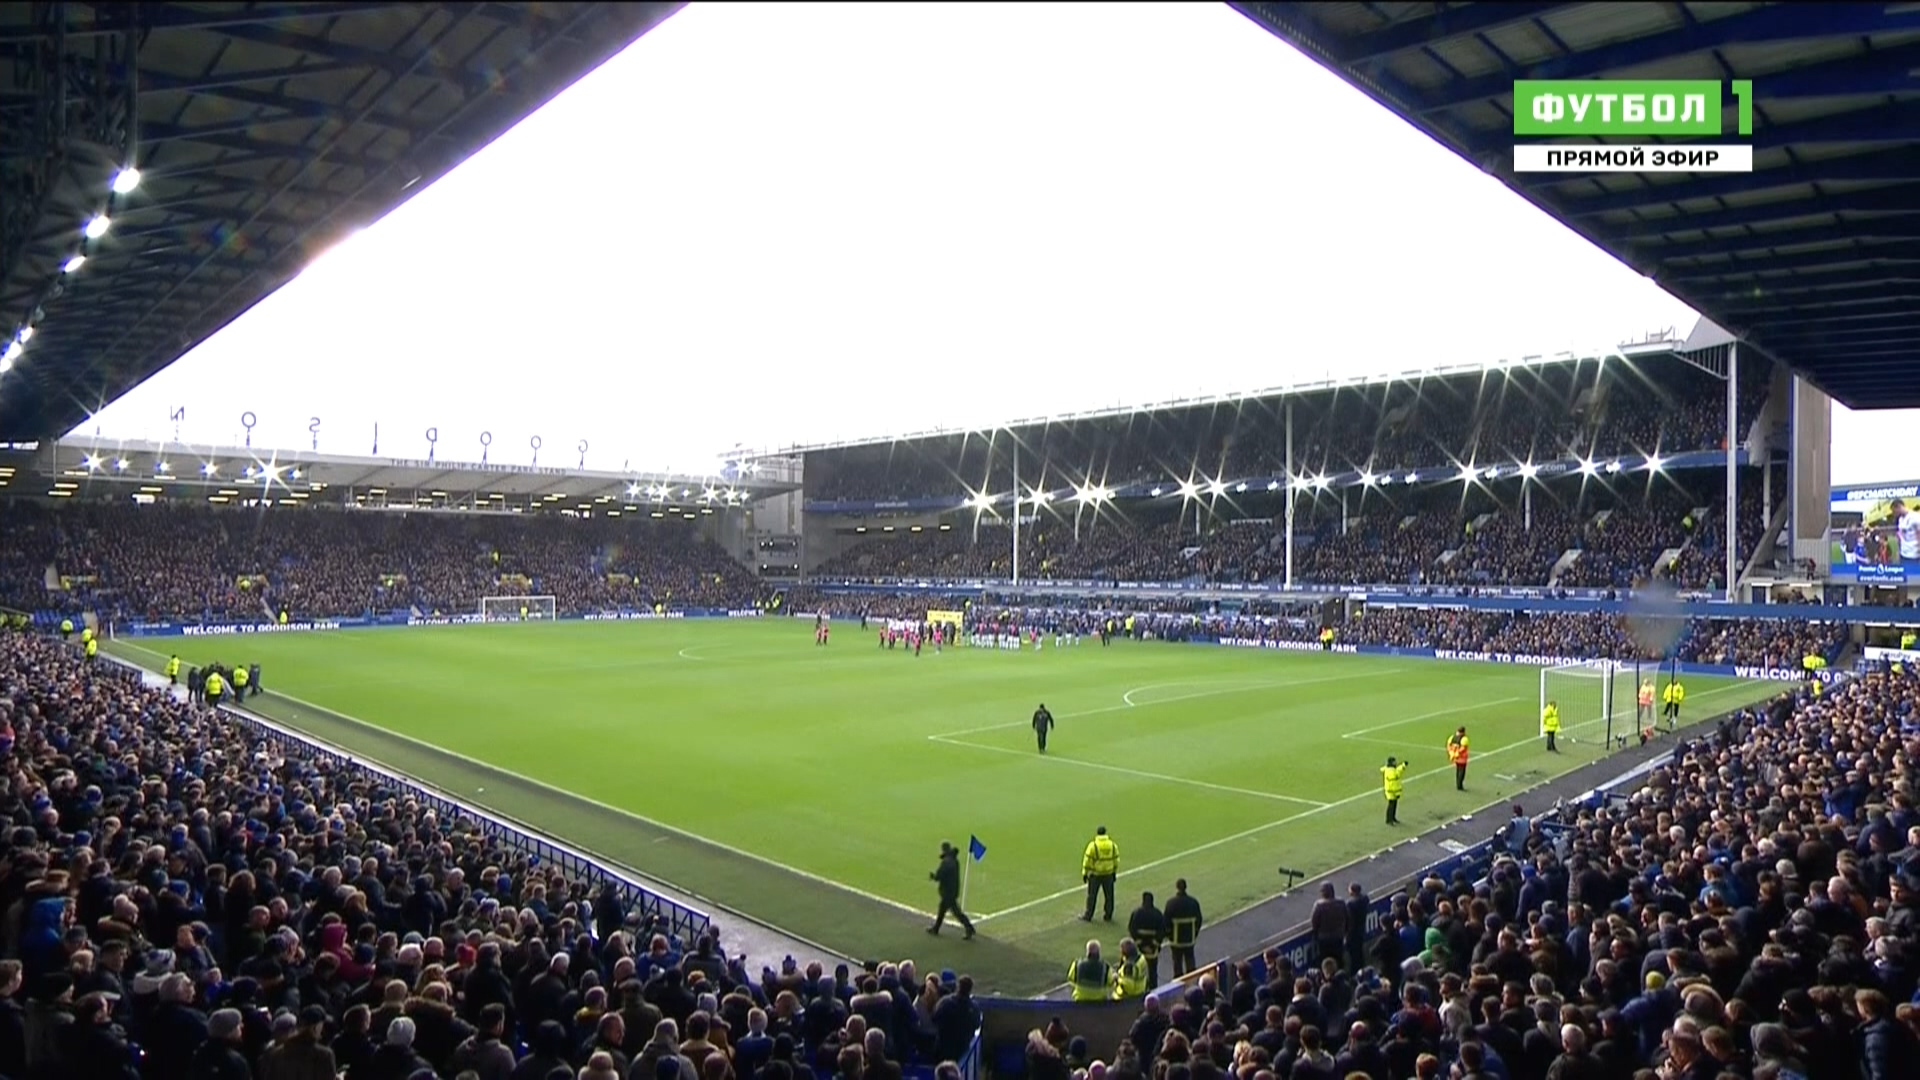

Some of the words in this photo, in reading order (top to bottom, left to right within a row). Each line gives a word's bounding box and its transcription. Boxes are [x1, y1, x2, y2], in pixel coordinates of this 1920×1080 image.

[182, 624, 237, 635] WELCOME
[240, 624, 255, 633] TO
[257, 622, 311, 632] GOODISON
[313, 621, 340, 630] PARK
[1219, 637, 1261, 647] WELCOME
[1264, 639, 1276, 648] TO
[1331, 643, 1357, 653] PARK
[1434, 649, 1491, 661] WELCOME
[1495, 652, 1511, 663] TO
[1515, 653, 1581, 667] GOODISON
[1734, 666, 1805, 682] WELCOM
[1815, 671, 1829, 683] TO
